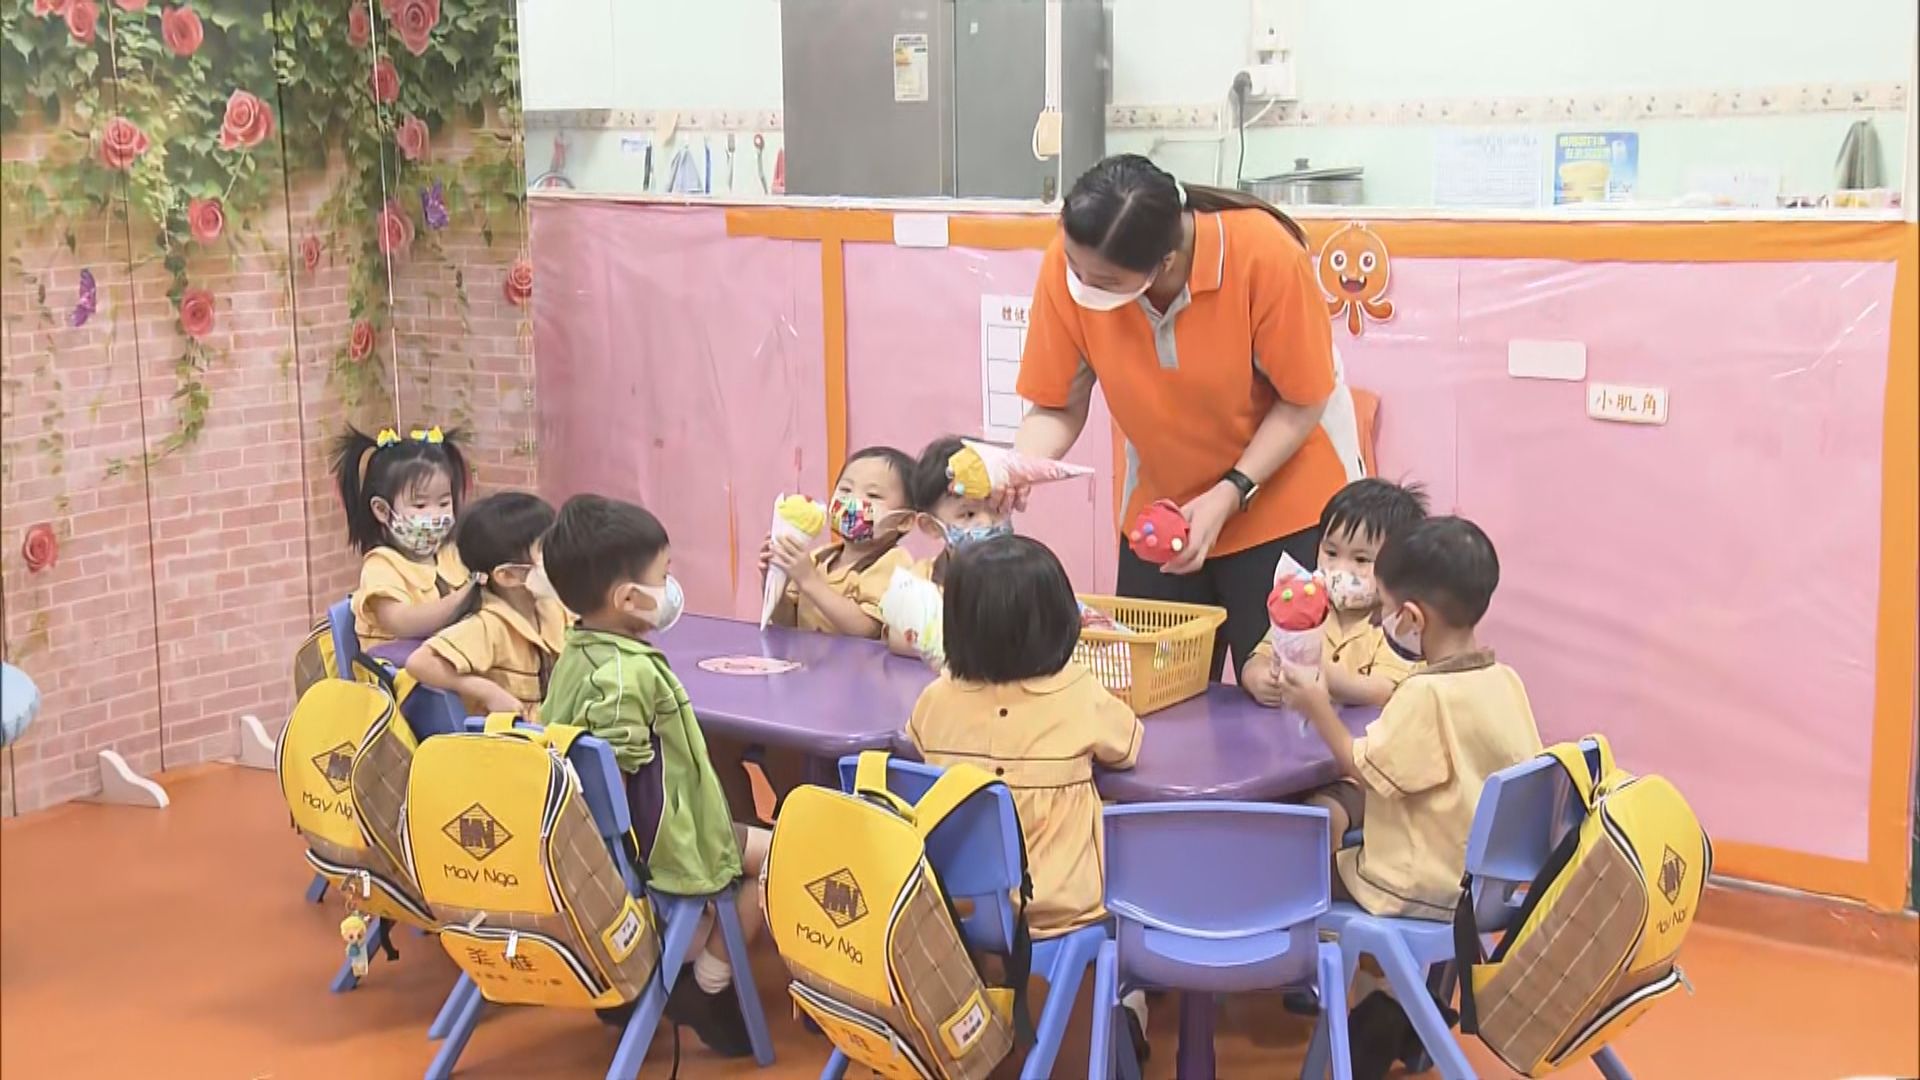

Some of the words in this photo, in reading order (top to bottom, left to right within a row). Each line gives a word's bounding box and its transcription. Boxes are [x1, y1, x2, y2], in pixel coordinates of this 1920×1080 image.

[1596, 390, 1661, 417] 小肌角
[303, 791, 333, 813] May
[443, 863, 479, 883] May
[483, 867, 519, 888] Nga
[796, 923, 834, 950] May
[837, 936, 864, 966] Nga
